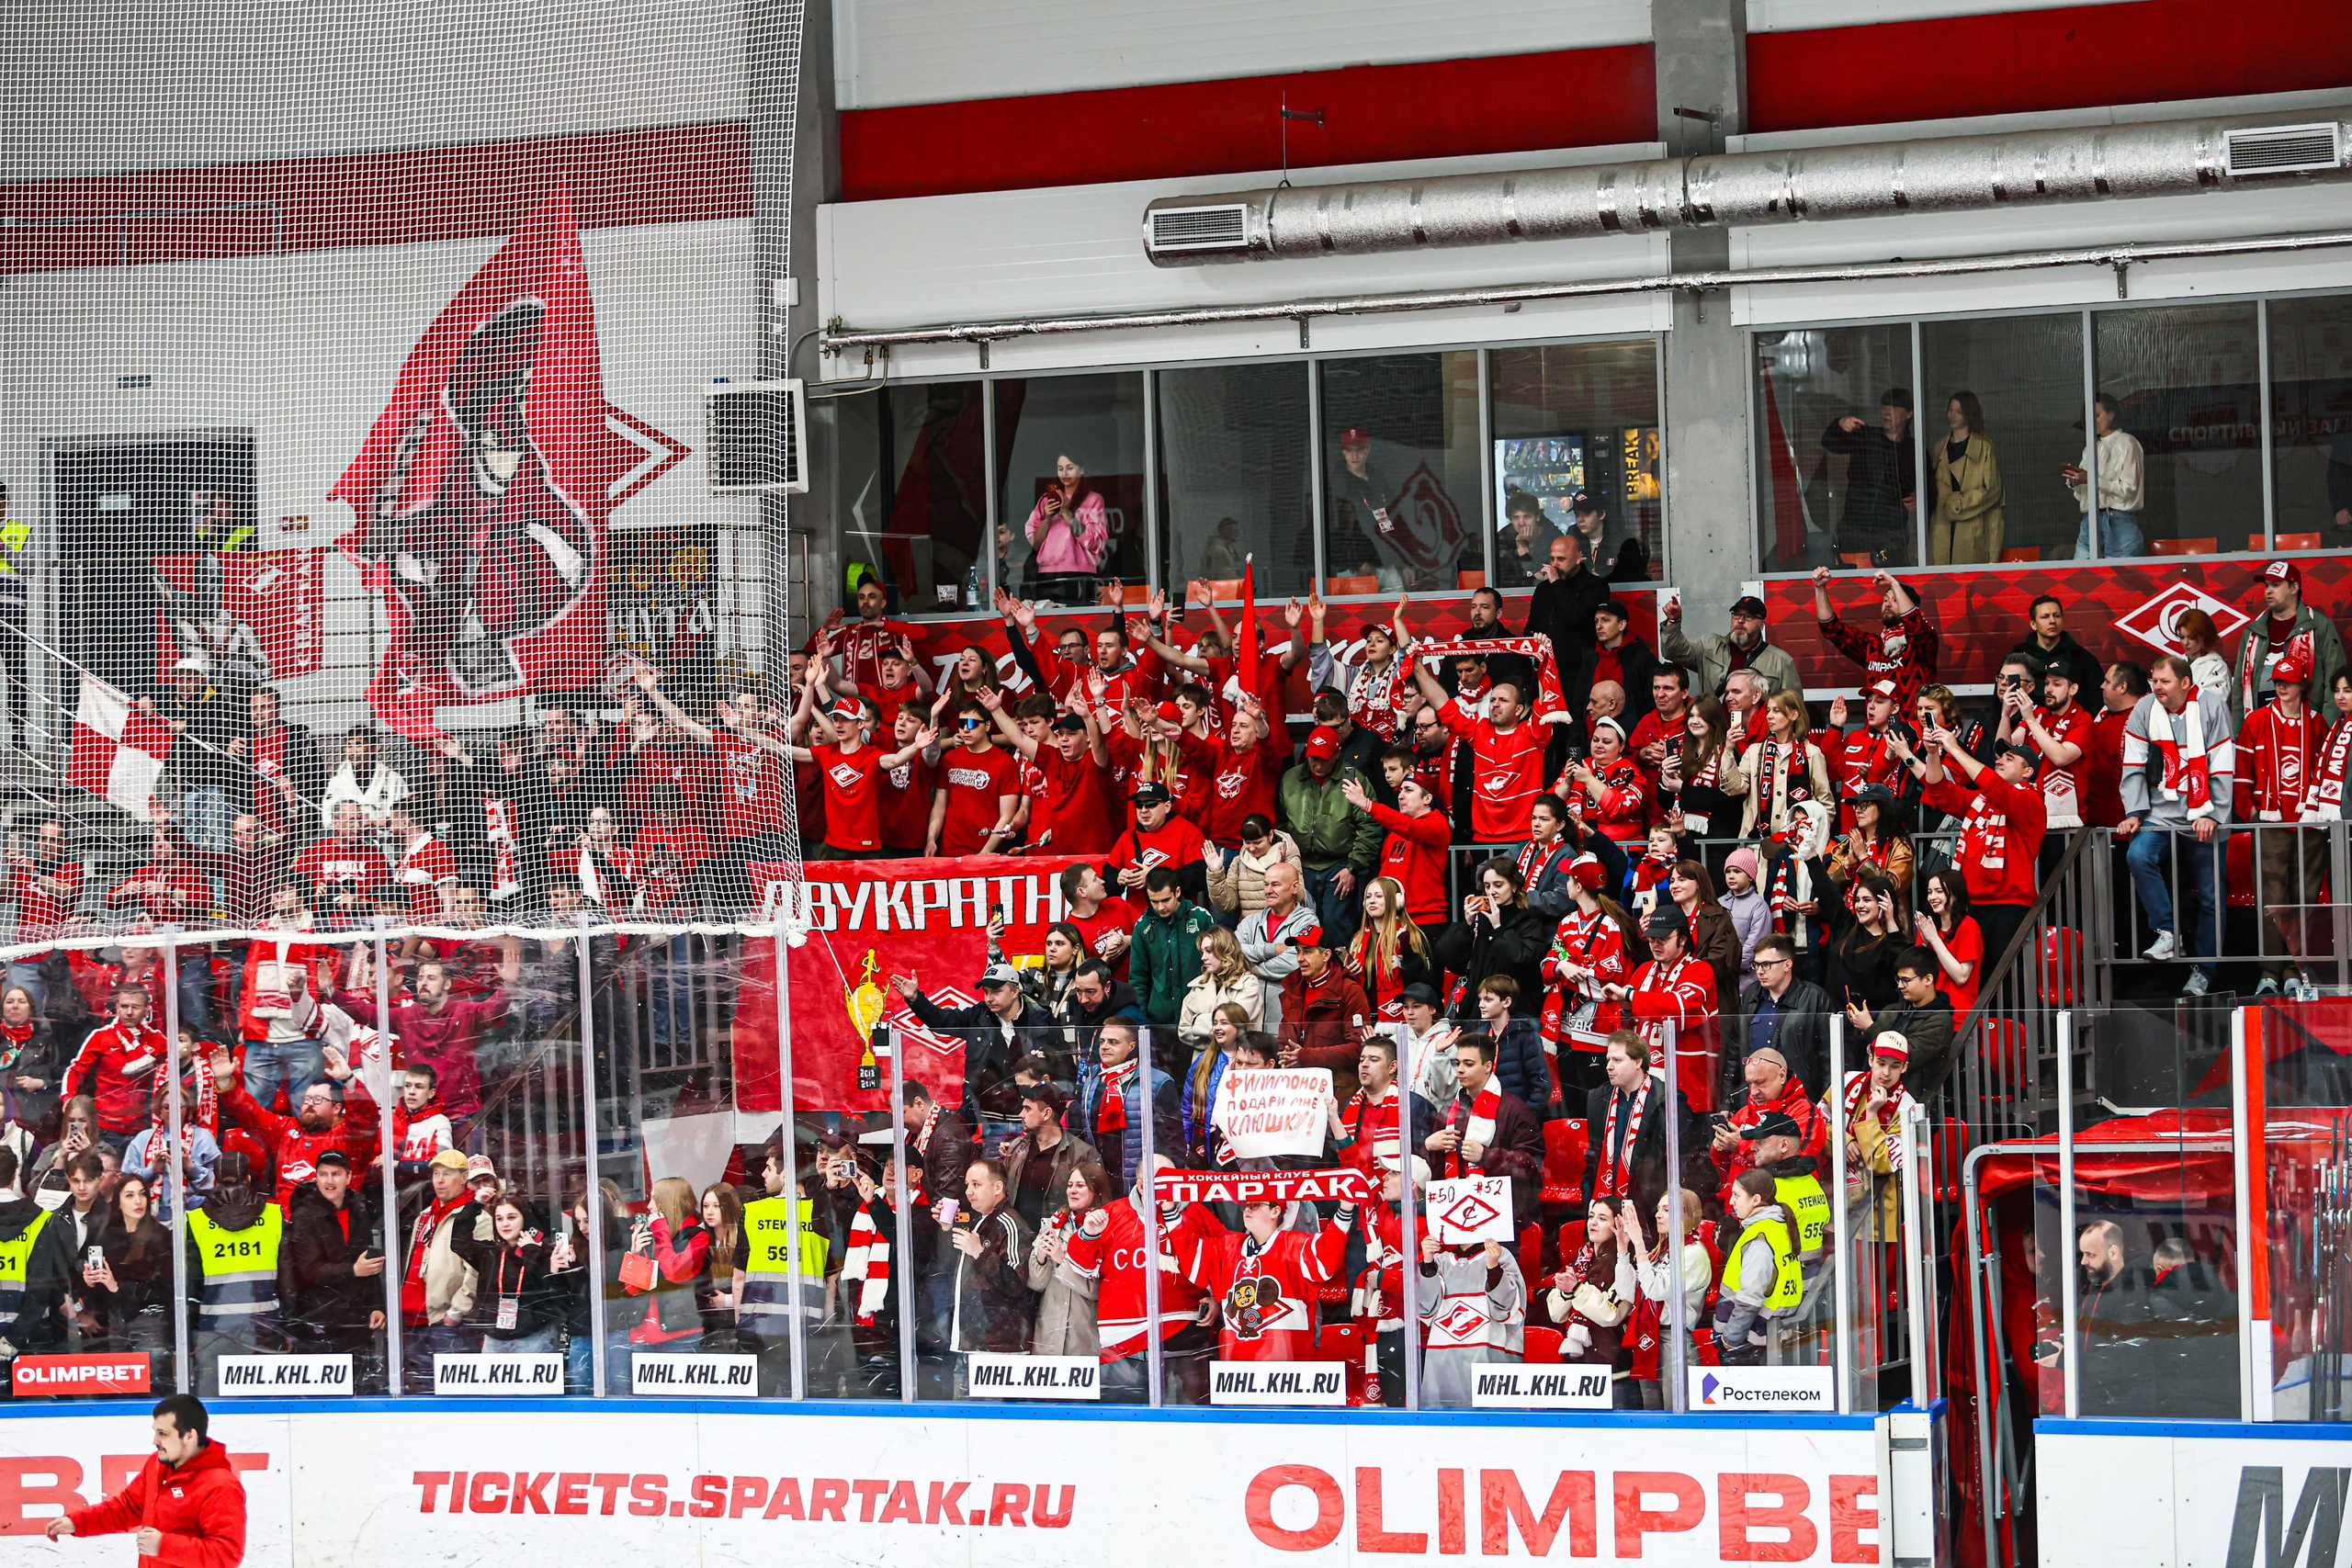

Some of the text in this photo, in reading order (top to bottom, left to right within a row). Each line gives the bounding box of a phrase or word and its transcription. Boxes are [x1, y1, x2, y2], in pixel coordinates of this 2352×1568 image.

[2169, 417, 2301, 442] СПОРТИВЫЙ
[1544, 1022, 1556, 1032] 1946
[860, 1068, 876, 1078] 2013
[1226, 1073, 1329, 1098] ФИЛИМОНОВ
[1227, 1096, 1318, 1112] ПОДАРИ МНЕ
[1227, 1111, 1316, 1137] КЛЮШКУ!
[1187, 1170, 1311, 1182] ХОККЕЙНЫЙ КЛУБ
[1427, 1179, 1503, 1203] #50 #52
[757, 1219, 813, 1233] STEWRD
[214, 1241, 262, 1258] 2181
[16, 1364, 145, 1384] OLIMPBET
[224, 1365, 347, 1385] MHL.KHL.RU
[439, 1364, 559, 1384] MHL.KHL.RU
[638, 1364, 752, 1385] MHL.KHL.RU
[974, 1365, 1095, 1388] MHL.KHL.RU
[1216, 1372, 1340, 1395] MHL.KHL.RU
[1477, 1374, 1607, 1397] MHL.KHL.RU
[1723, 1386, 1820, 1404] Ростелеком
[413, 1471, 1076, 1528] TICKETS.SPARTAK.RU
